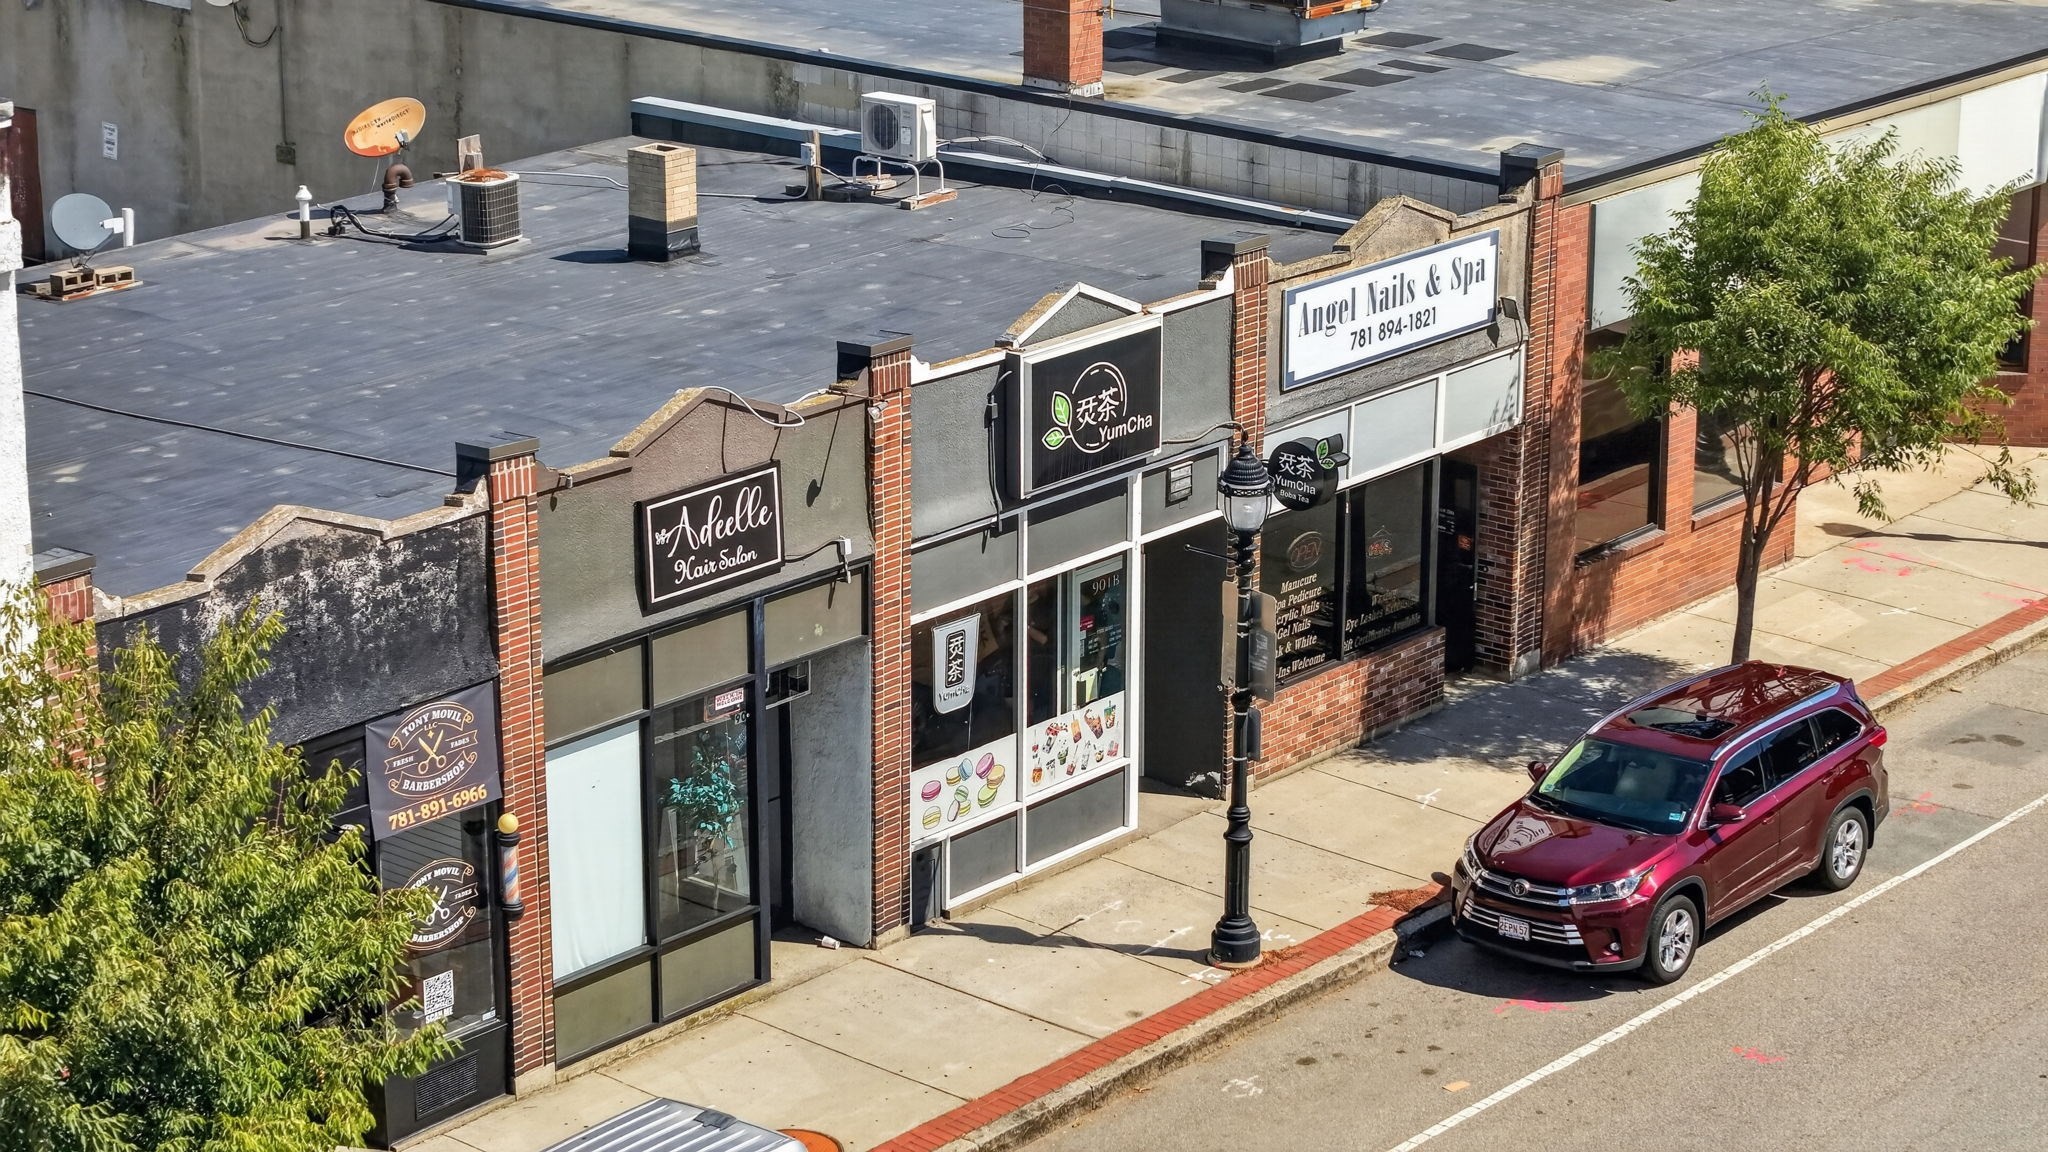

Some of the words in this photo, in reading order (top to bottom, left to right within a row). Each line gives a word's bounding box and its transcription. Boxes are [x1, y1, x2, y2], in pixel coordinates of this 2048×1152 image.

[1298, 287, 1356, 337] Angel
[1366, 272, 1415, 316] Nails
[1425, 263, 1441, 298] &
[1450, 256, 1486, 295] Spa
[1350, 326, 1372, 350] 781
[1378, 306, 1436, 341] 894-1821
[1099, 414, 1152, 442] YumCha
[1275, 474, 1316, 495] YumCha
[1280, 489, 1296, 500] Boba
[1298, 494, 1310, 503] Tea
[674, 555, 718, 585] Hair
[718, 545, 757, 570] Salon
[1281, 573, 1318, 594] Manicure
[1288, 586, 1322, 606] Pedicure
[1276, 607, 1299, 626] crylic
[1300, 600, 1320, 616] Nails
[1277, 625, 1290, 640] Gel
[1291, 618, 1312, 635] Nails
[1345, 618, 1358, 633] Eye
[1285, 641, 1292, 654] &
[1294, 634, 1317, 650] White
[1291, 653, 1326, 672] Welcome
[402, 712, 430, 737] TONY
[431, 709, 462, 723] MOVIL
[424, 721, 438, 731] LLC
[450, 736, 470, 748] FADES
[392, 755, 414, 768] FRESH
[402, 760, 465, 792] BARBERSHOP
[388, 784, 487, 830] 781-891-6966
[434, 866, 460, 878] MOVIL
[412, 916, 465, 943] BARBERSHOP
[1499, 921, 1518, 934] 2EPN
[1519, 925, 1528, 936] 57
